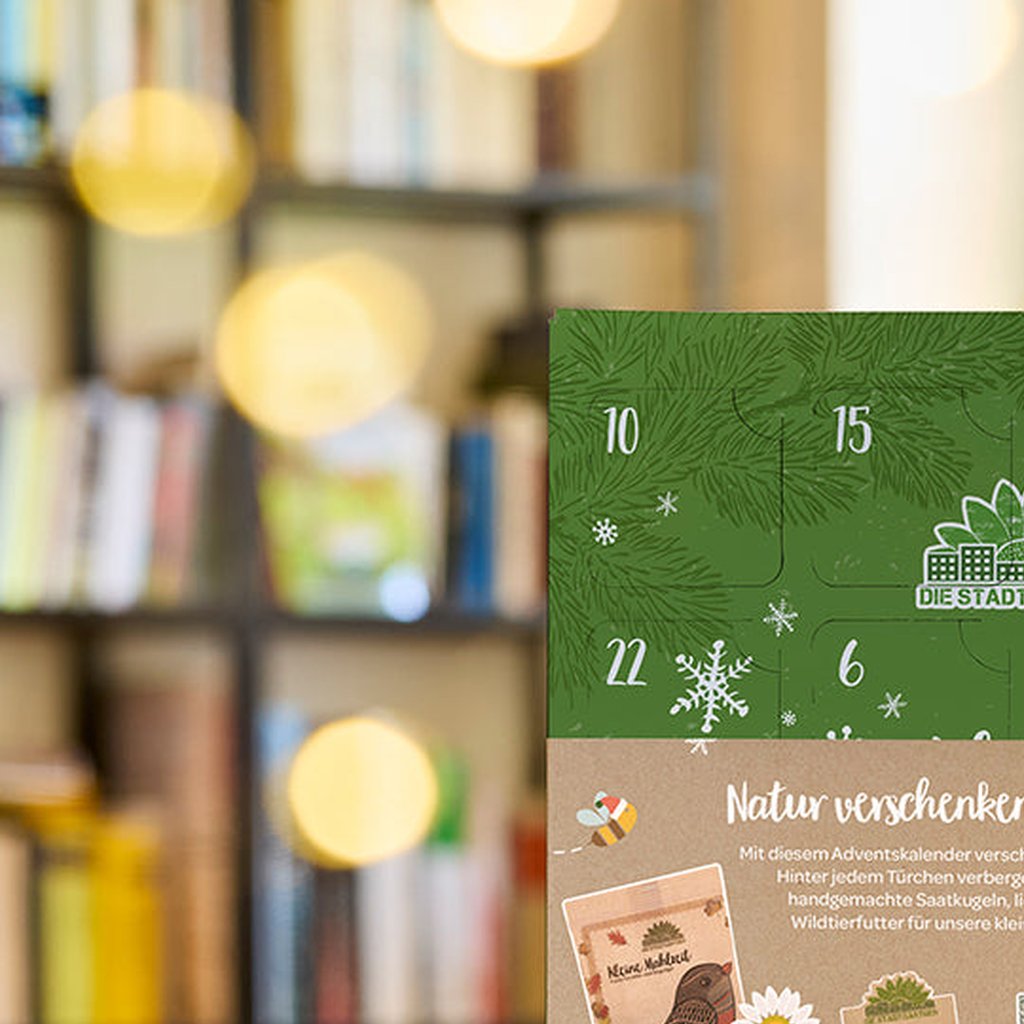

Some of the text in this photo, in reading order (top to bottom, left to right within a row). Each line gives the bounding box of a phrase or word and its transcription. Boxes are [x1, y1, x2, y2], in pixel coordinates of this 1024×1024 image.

[603, 406, 640, 454] 10
[833, 405, 873, 454] 15
[919, 586, 953, 606] DIE
[605, 638, 647, 686] 22
[839, 639, 865, 687] 6
[727, 780, 828, 824] Natur
[739, 846, 764, 861] Mit
[768, 846, 829, 861] diesem
[831, 846, 970, 862] Adventskalender
[776, 869, 828, 884] Hinter
[830, 869, 884, 887] jedem
[887, 869, 954, 884] Türchen
[788, 892, 912, 910] handgemachte
[915, 893, 1010, 911] Saatkugeln,
[791, 915, 905, 930] Wildtierfutter
[907, 915, 931, 930] für
[935, 918, 991, 931] unsere
